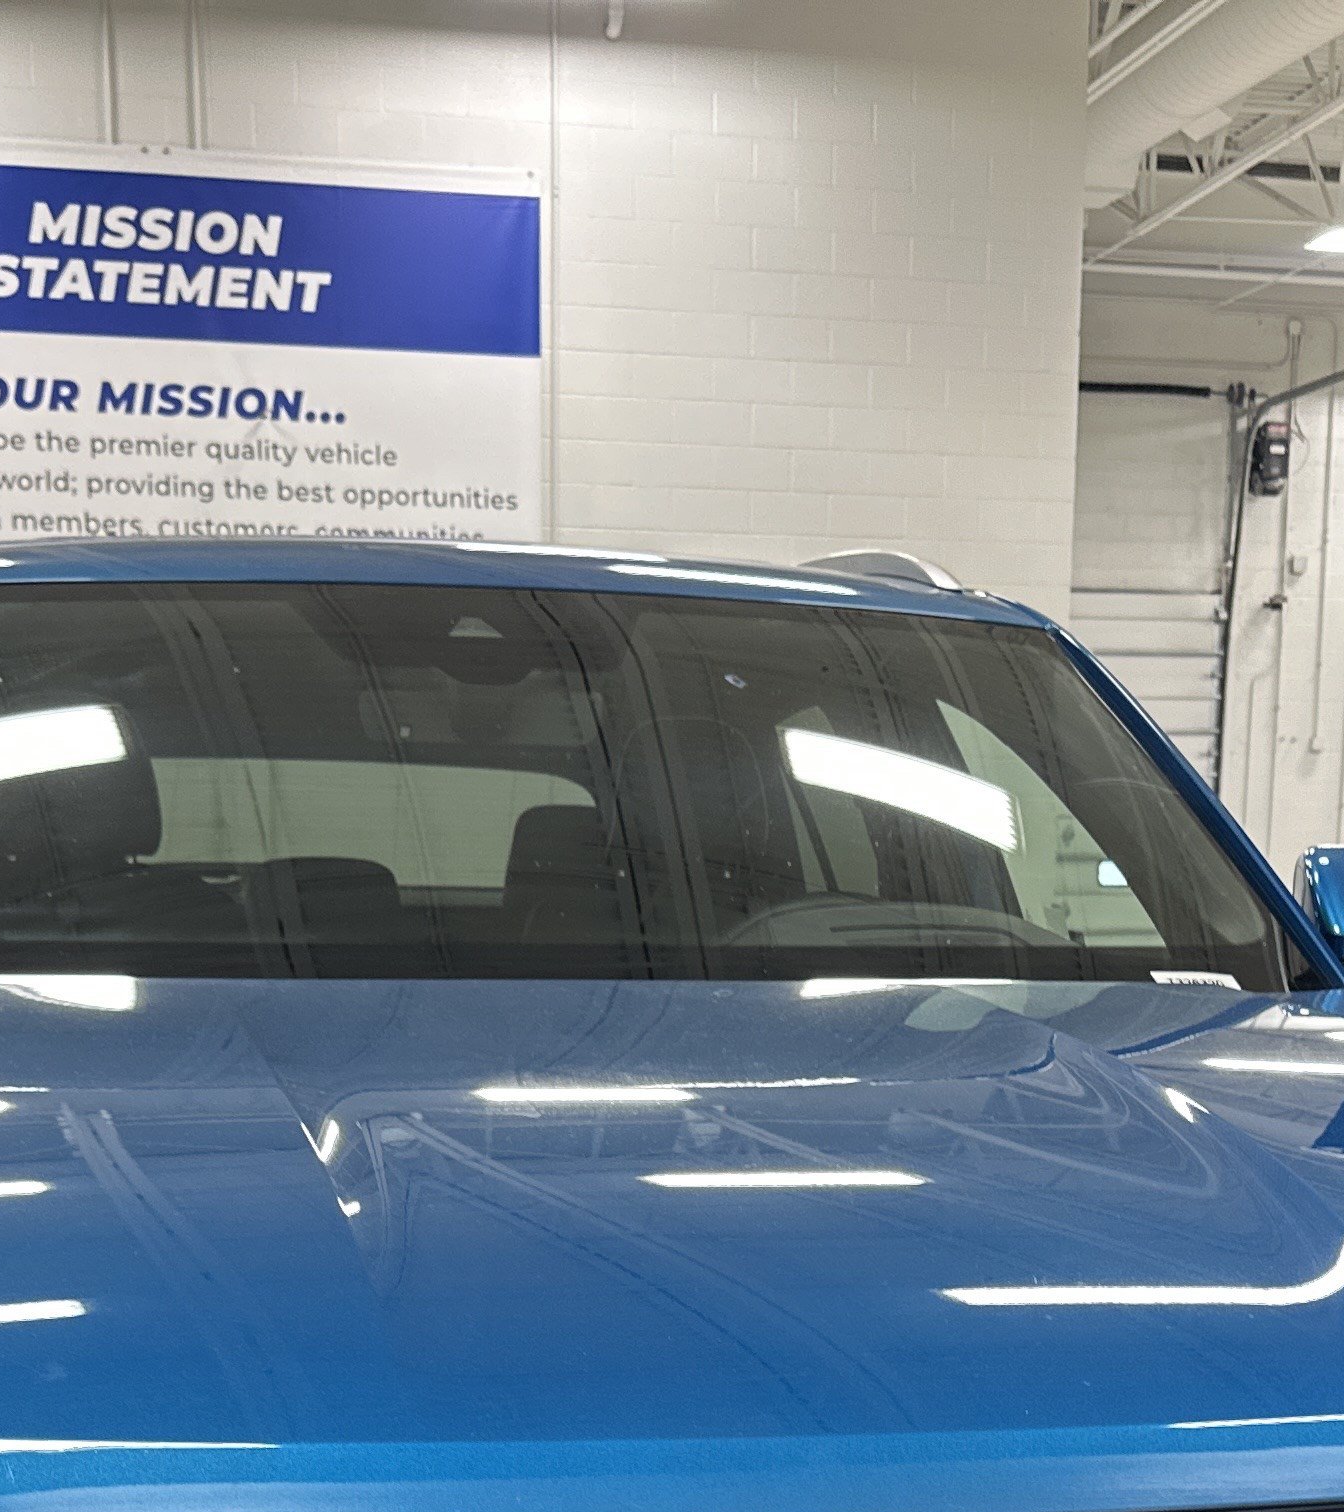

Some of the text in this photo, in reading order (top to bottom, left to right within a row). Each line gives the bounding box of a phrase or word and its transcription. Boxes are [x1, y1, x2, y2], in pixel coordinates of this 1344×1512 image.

[27, 201, 284, 258] MISSION
[97, 381, 347, 425] MISSION...
[34, 431, 80, 454] the
[89, 433, 196, 459] premier
[205, 438, 298, 467] quality
[305, 442, 398, 467] vehicle
[86, 473, 215, 503] providing
[223, 478, 268, 501] the
[276, 480, 336, 504] best
[342, 486, 520, 512] opportunities
